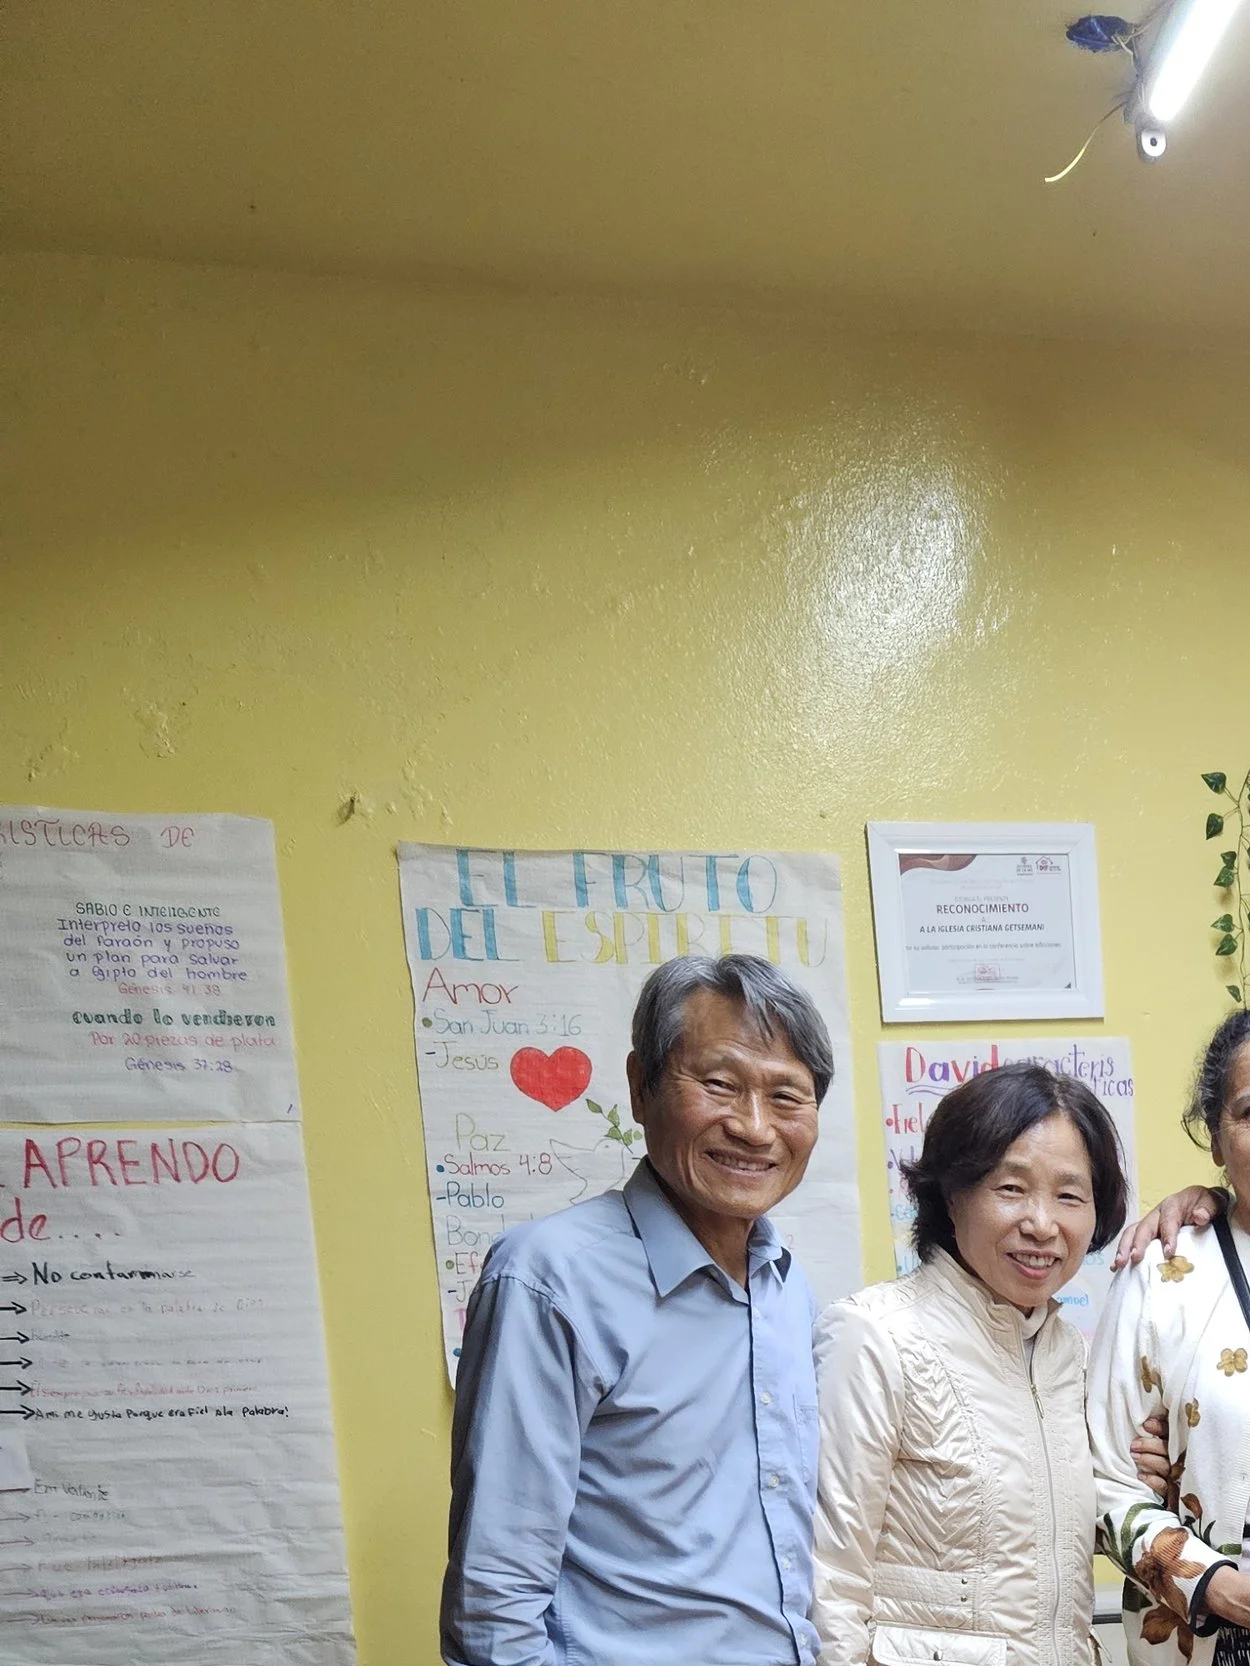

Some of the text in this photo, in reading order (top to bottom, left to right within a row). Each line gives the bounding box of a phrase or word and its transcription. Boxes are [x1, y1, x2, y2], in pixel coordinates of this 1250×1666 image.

[160, 826, 194, 848] DE
[456, 849, 777, 913] EL FRUTO
[76, 902, 117, 916] SABIO
[122, 904, 131, 916] E
[936, 903, 1029, 914] RECONOCIMIENTO
[150, 922, 173, 934] los
[416, 907, 828, 968] DEL ESPIRITU
[938, 925, 965, 933] IGLESIA
[966, 924, 1003, 932] CRISTIANA
[63, 934, 86, 947] del
[163, 939, 172, 952] y
[182, 939, 240, 952] propuso
[66, 952, 87, 962] un
[93, 950, 131, 965] plan
[140, 953, 179, 968] para
[69, 968, 80, 977] a
[147, 967, 173, 979] del
[186, 967, 248, 981] hombre
[422, 967, 519, 1004] Amor
[153, 1008, 174, 1025] lo
[433, 1008, 582, 1037] San Juan 3:16
[204, 1034, 224, 1048] de
[231, 1033, 276, 1052] plata
[906, 1044, 998, 1084] David
[455, 1112, 511, 1151] Paz
[23, 1137, 241, 1189] APRENDO
[444, 1151, 553, 1176] Salmos 4:8
[32, 1261, 63, 1286] No
[64, 1410, 83, 1419] me
